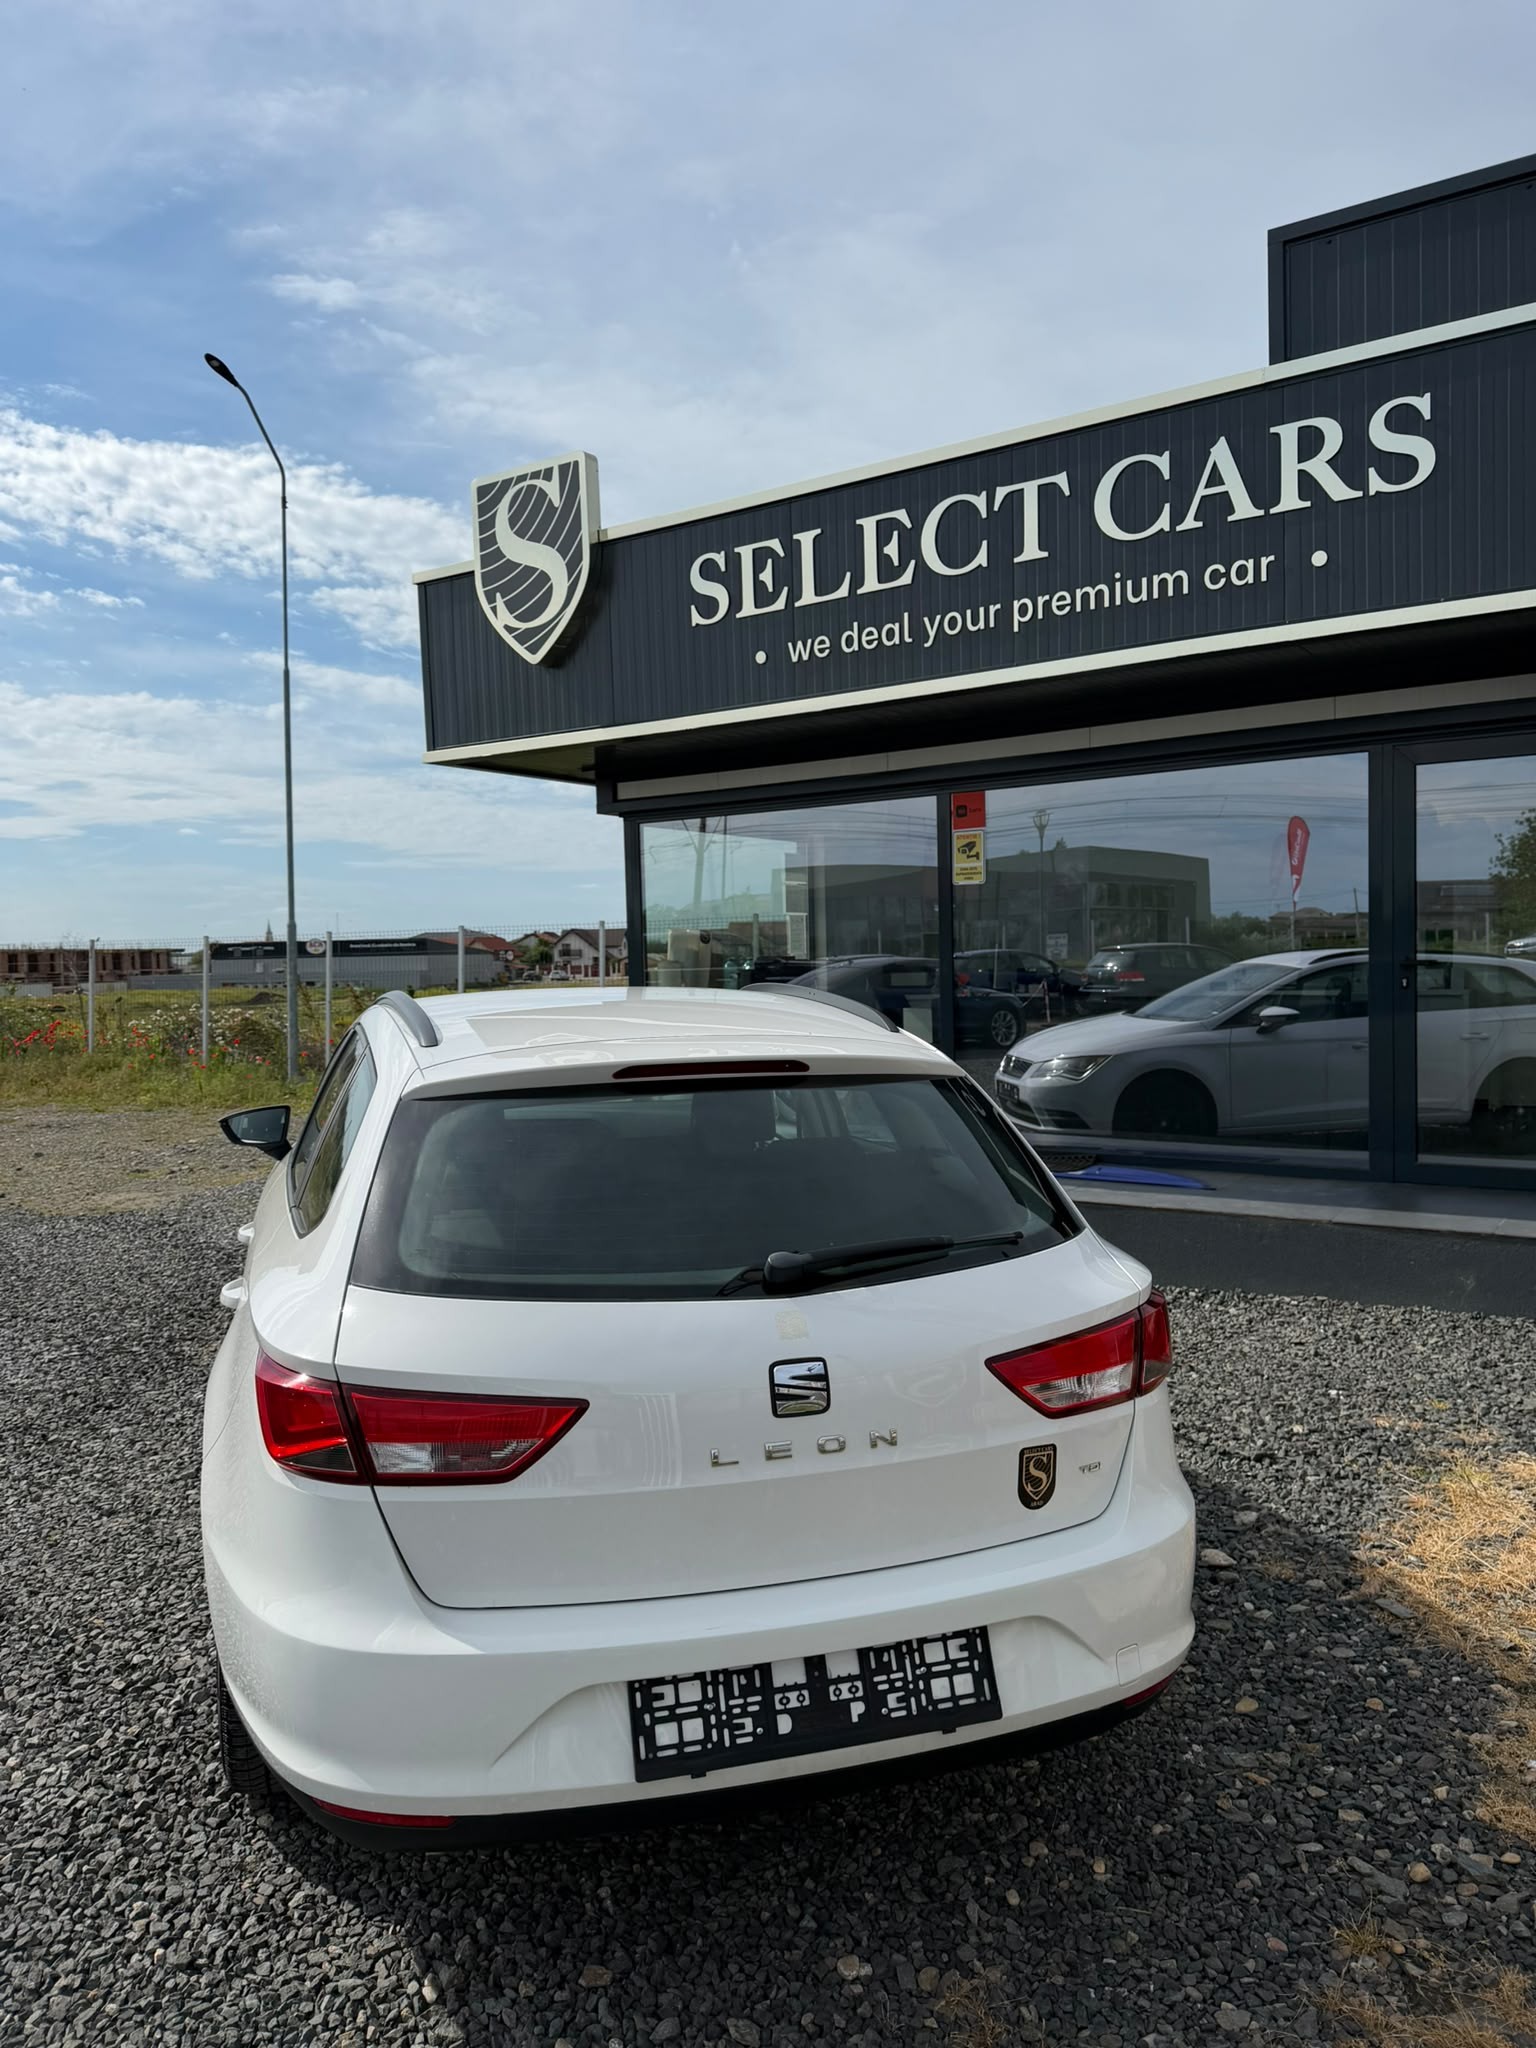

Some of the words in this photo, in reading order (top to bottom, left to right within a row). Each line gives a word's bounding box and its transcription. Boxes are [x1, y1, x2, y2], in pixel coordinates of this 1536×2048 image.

[689, 470, 1071, 627] SELECT
[1093, 392, 1436, 541] CARS
[787, 635, 831, 663] we
[840, 611, 913, 653] deal
[923, 603, 1002, 648] your
[1013, 569, 1189, 633] premium
[1203, 554, 1275, 590] car
[710, 1428, 898, 1467] LEON
